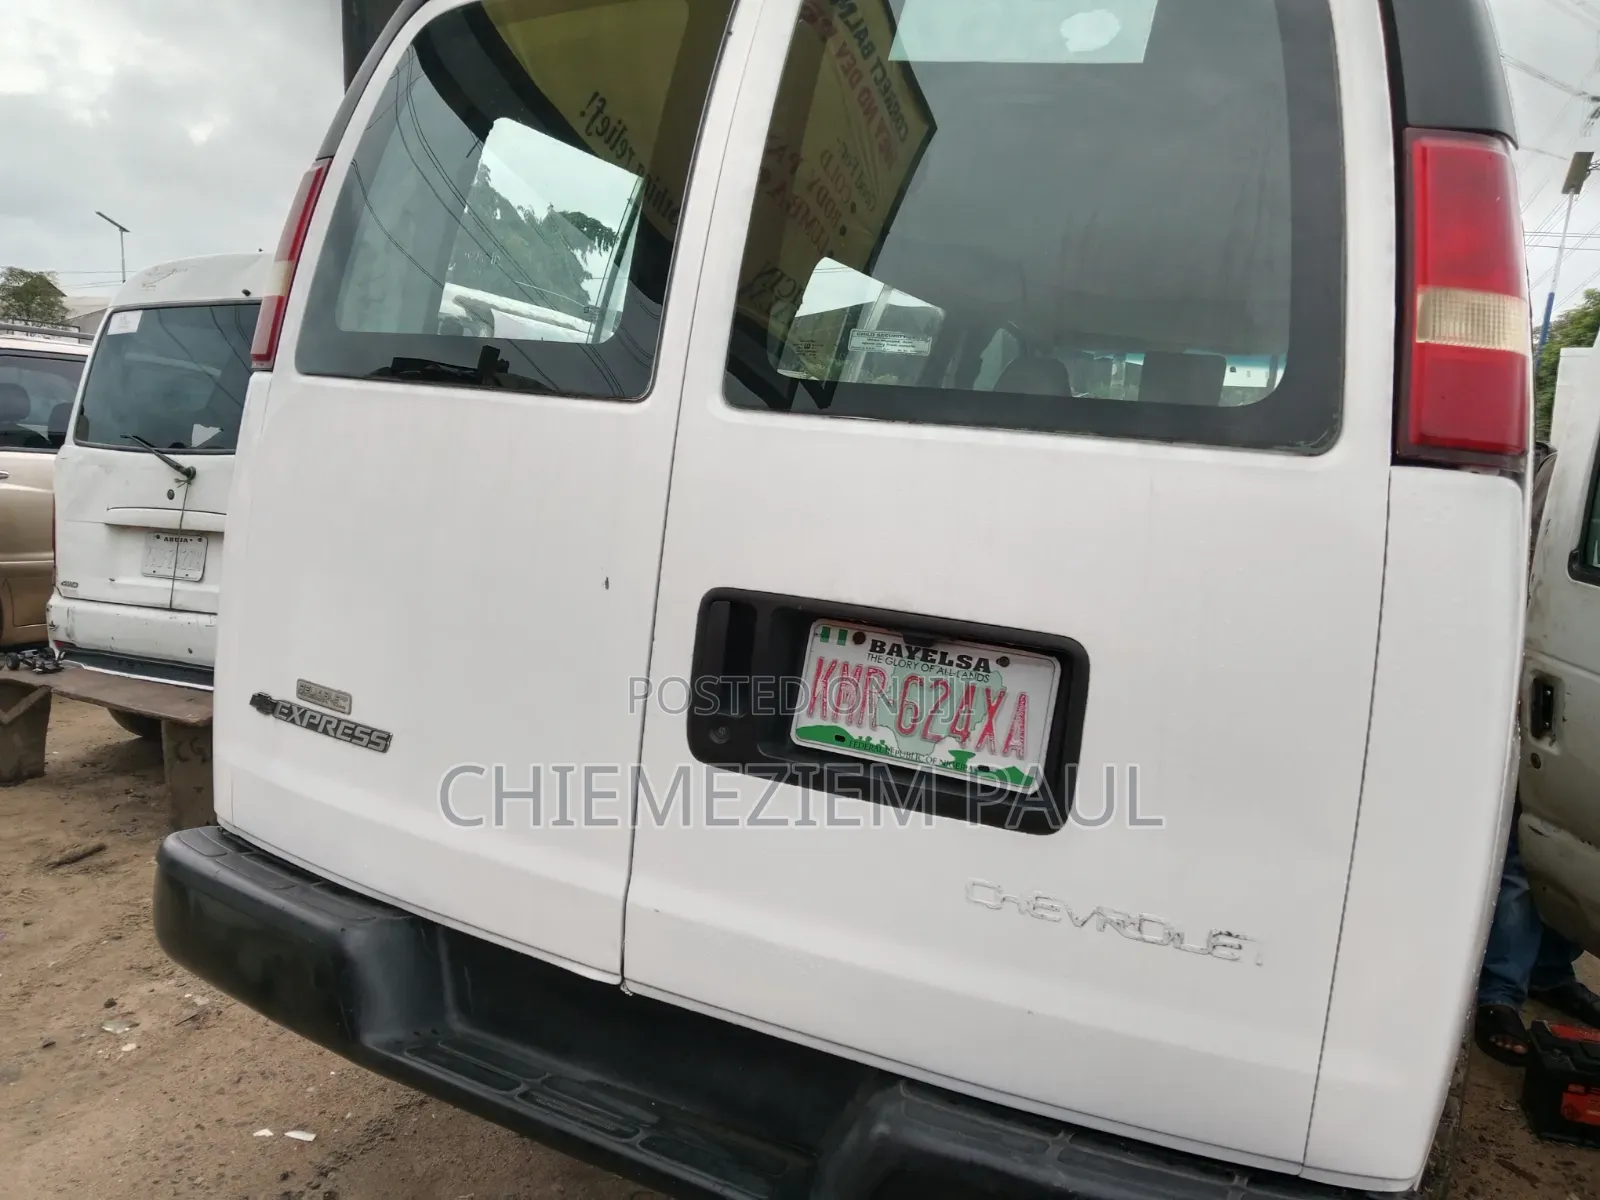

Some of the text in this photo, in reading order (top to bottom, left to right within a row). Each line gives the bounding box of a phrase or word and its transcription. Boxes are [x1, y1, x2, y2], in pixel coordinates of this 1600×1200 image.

[867, 653, 882, 664] THE
[884, 656, 919, 670] GLORY
[921, 663, 936, 672] OF
[869, 639, 991, 673] BAYELSA
[274, 701, 389, 752] EXPRESS
[925, 755, 938, 765] OF
